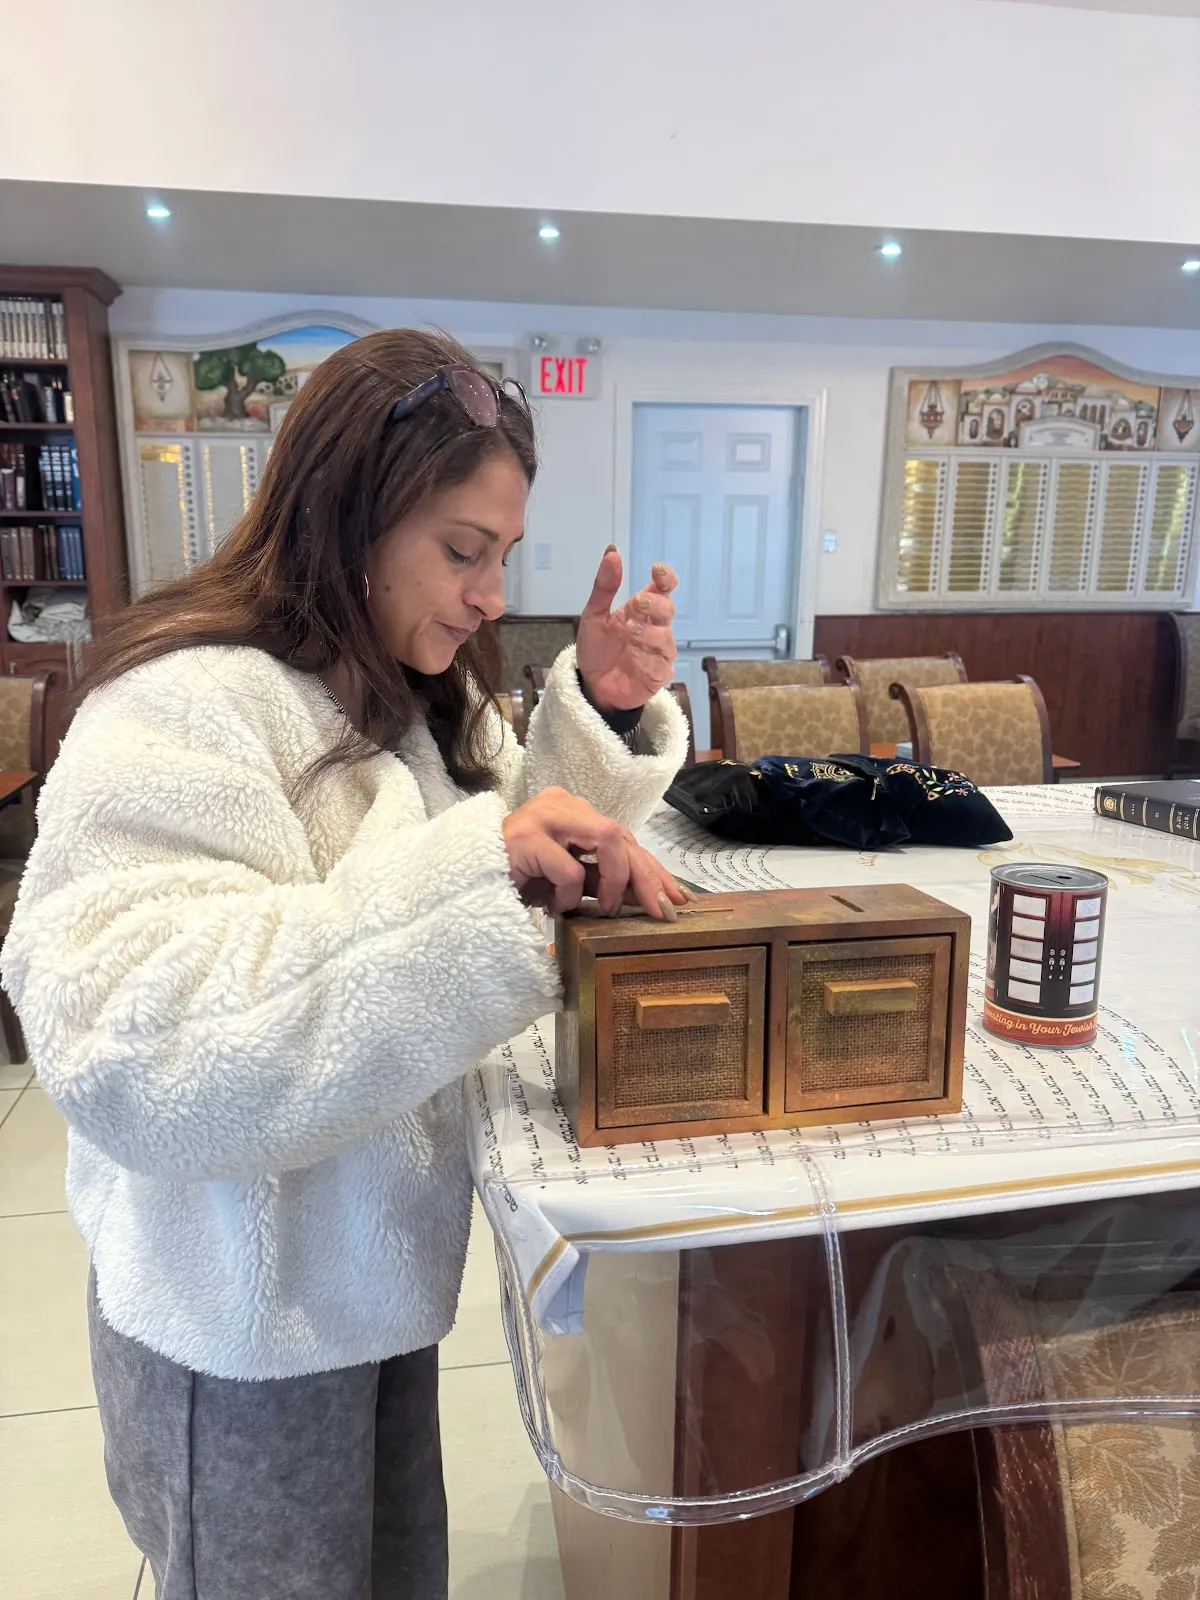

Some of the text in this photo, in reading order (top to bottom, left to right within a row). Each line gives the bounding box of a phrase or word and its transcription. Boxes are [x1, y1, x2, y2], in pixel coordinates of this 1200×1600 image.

[541, 356, 587, 393] EXIT
[1015, 1020, 1028, 1031] in
[1029, 1022, 1062, 1035] Your
[1062, 1021, 1093, 1036] Jewish
